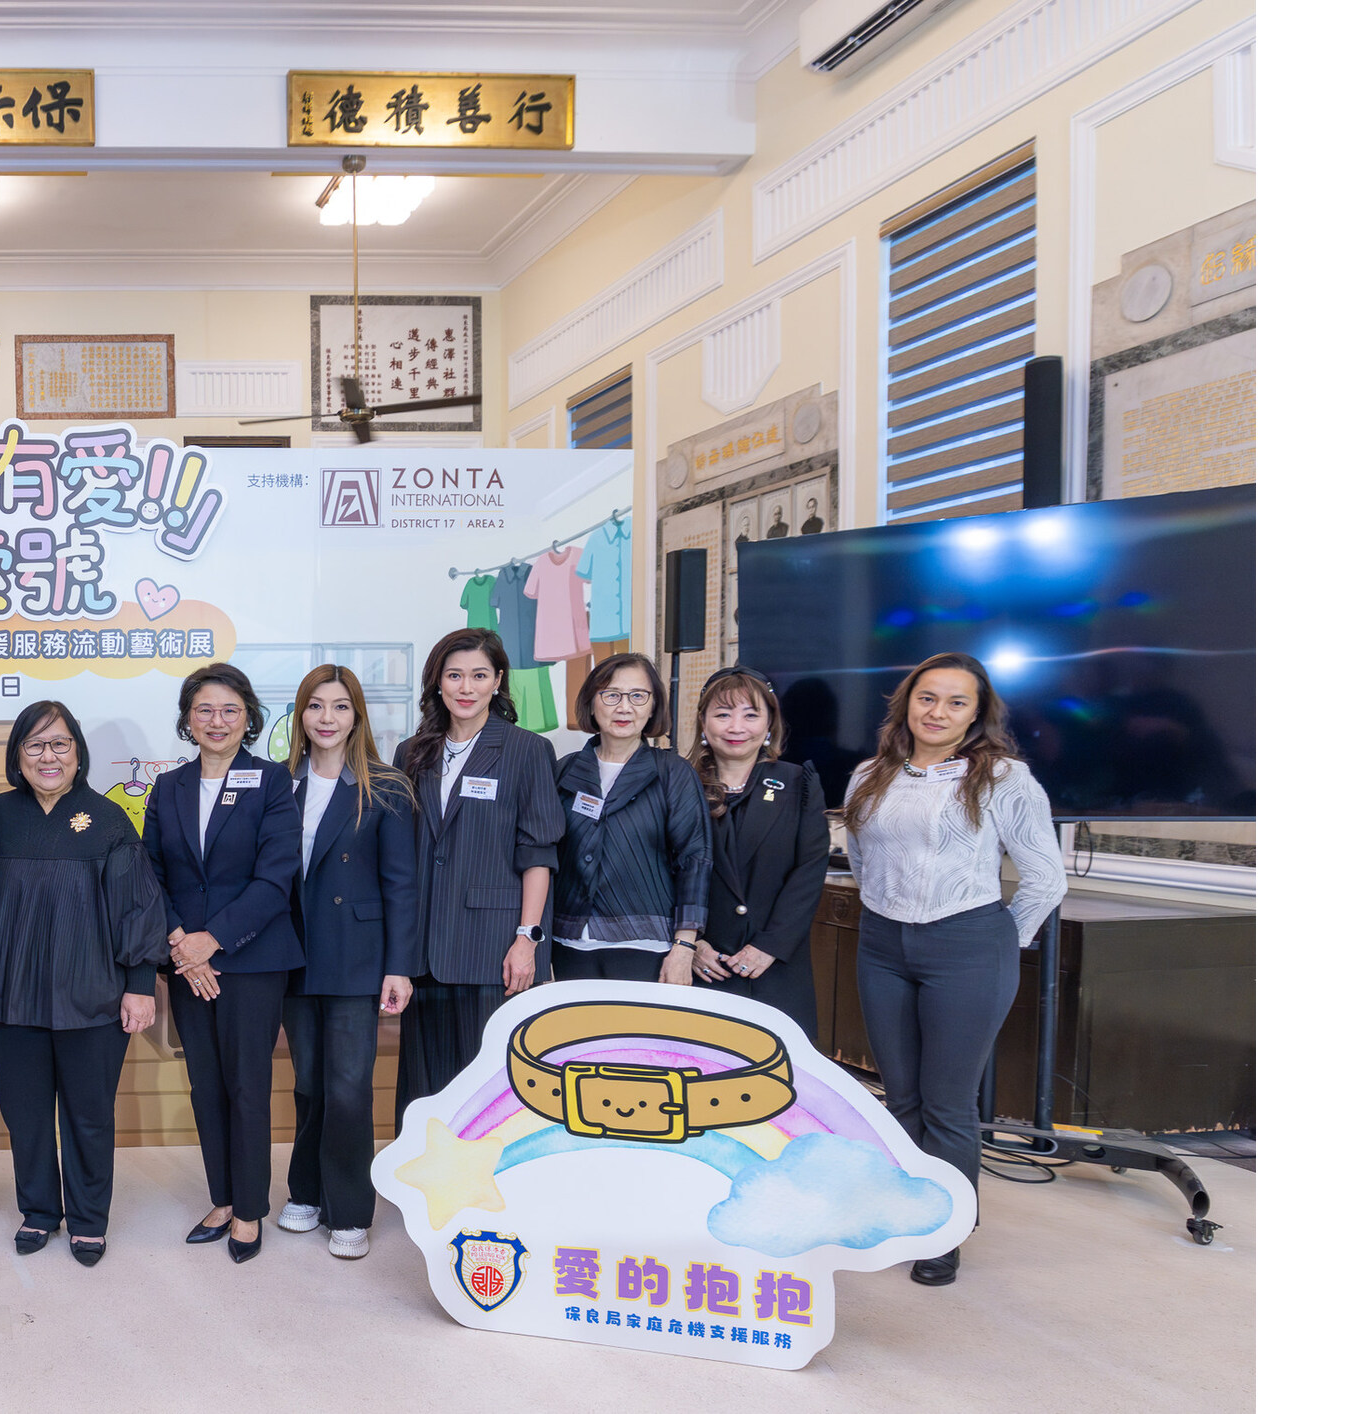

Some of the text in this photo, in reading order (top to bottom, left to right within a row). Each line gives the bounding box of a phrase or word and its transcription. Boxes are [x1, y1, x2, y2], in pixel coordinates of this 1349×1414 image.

[389, 341, 404, 391] 心相連
[424, 338, 439, 390] 傳經典
[392, 468, 504, 489] ZONTA
[392, 493, 504, 507] INTERNATIONAL
[392, 519, 504, 528] DISTRICT 17 AREA 2
[554, 1245, 813, 1327] 愛的抱抱
[565, 1307, 792, 1349] 保良局家庭危機支援服務
